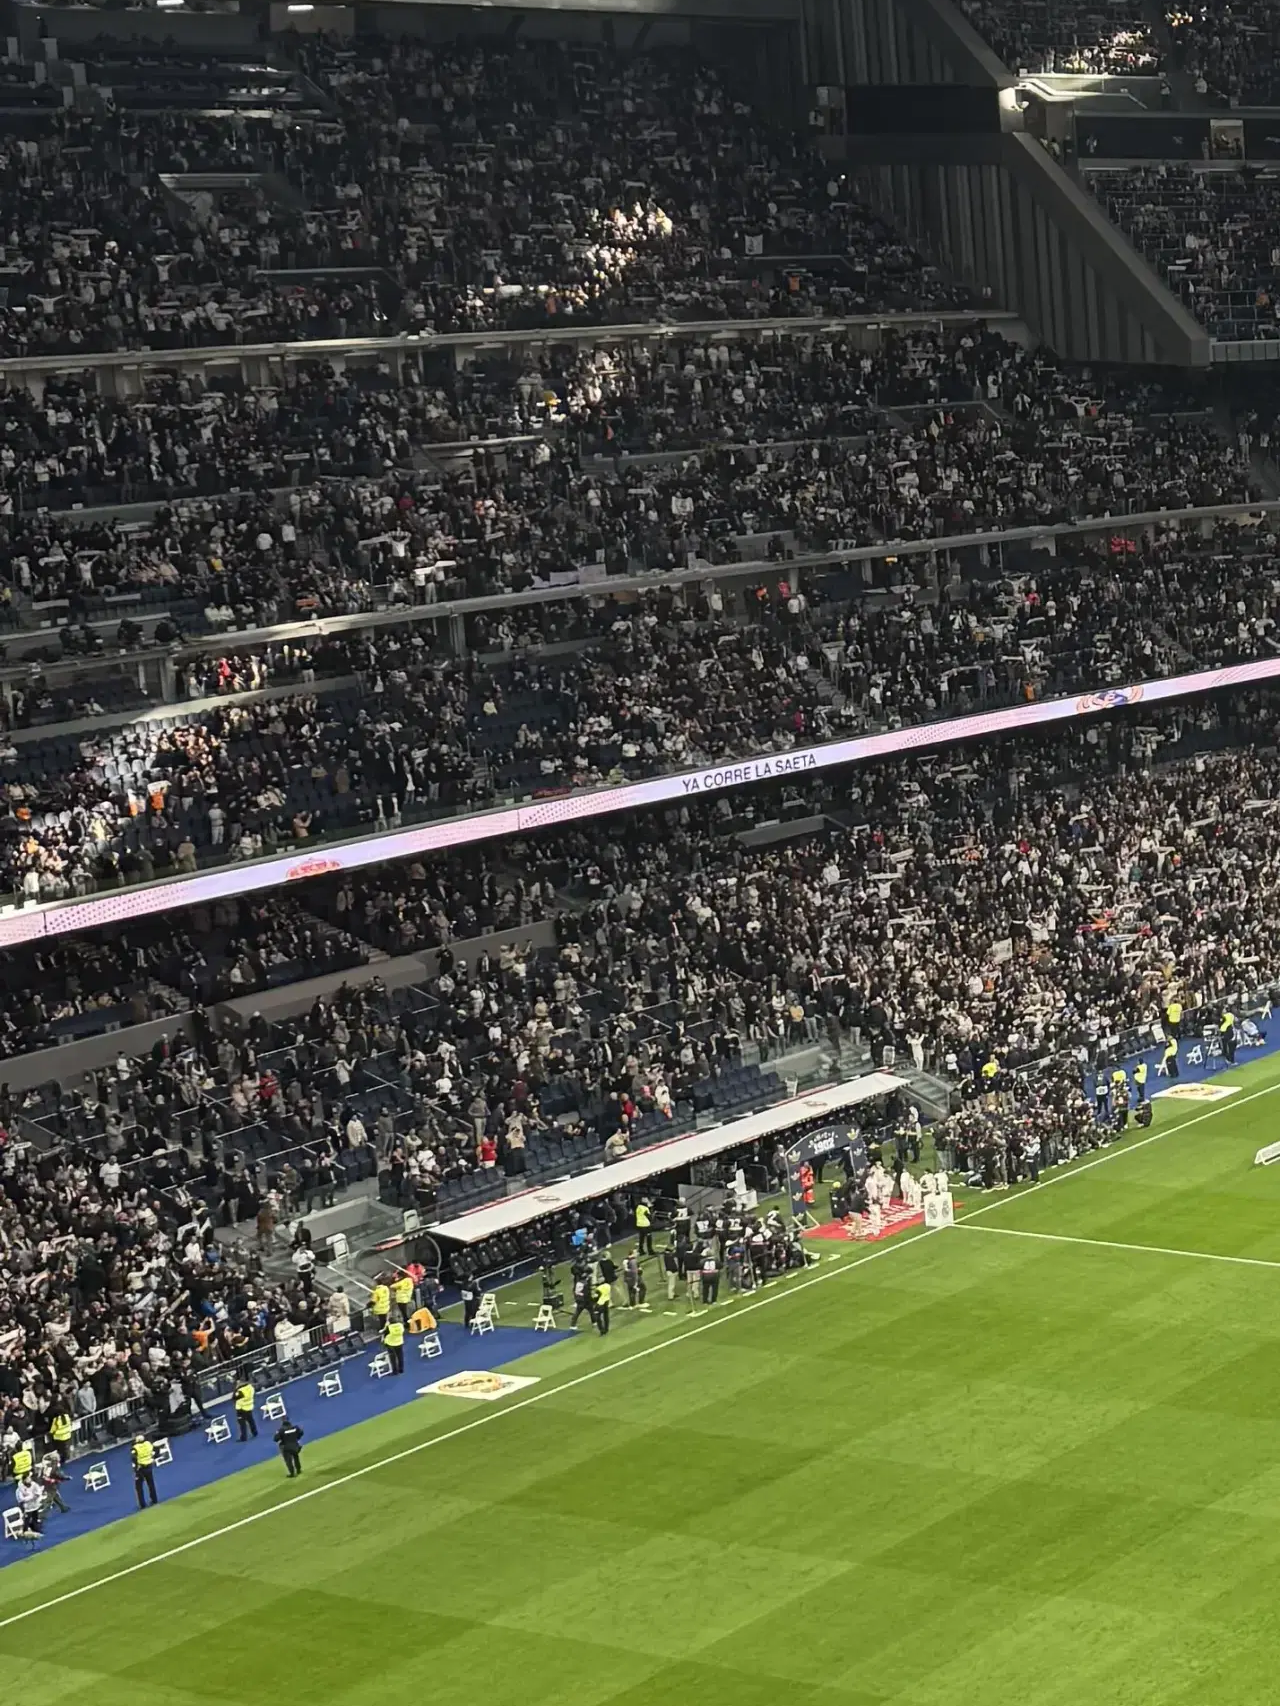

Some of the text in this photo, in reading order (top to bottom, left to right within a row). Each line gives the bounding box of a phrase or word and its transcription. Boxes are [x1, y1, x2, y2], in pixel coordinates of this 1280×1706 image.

[682, 754, 817, 792] YA CORRE LA SAETA
